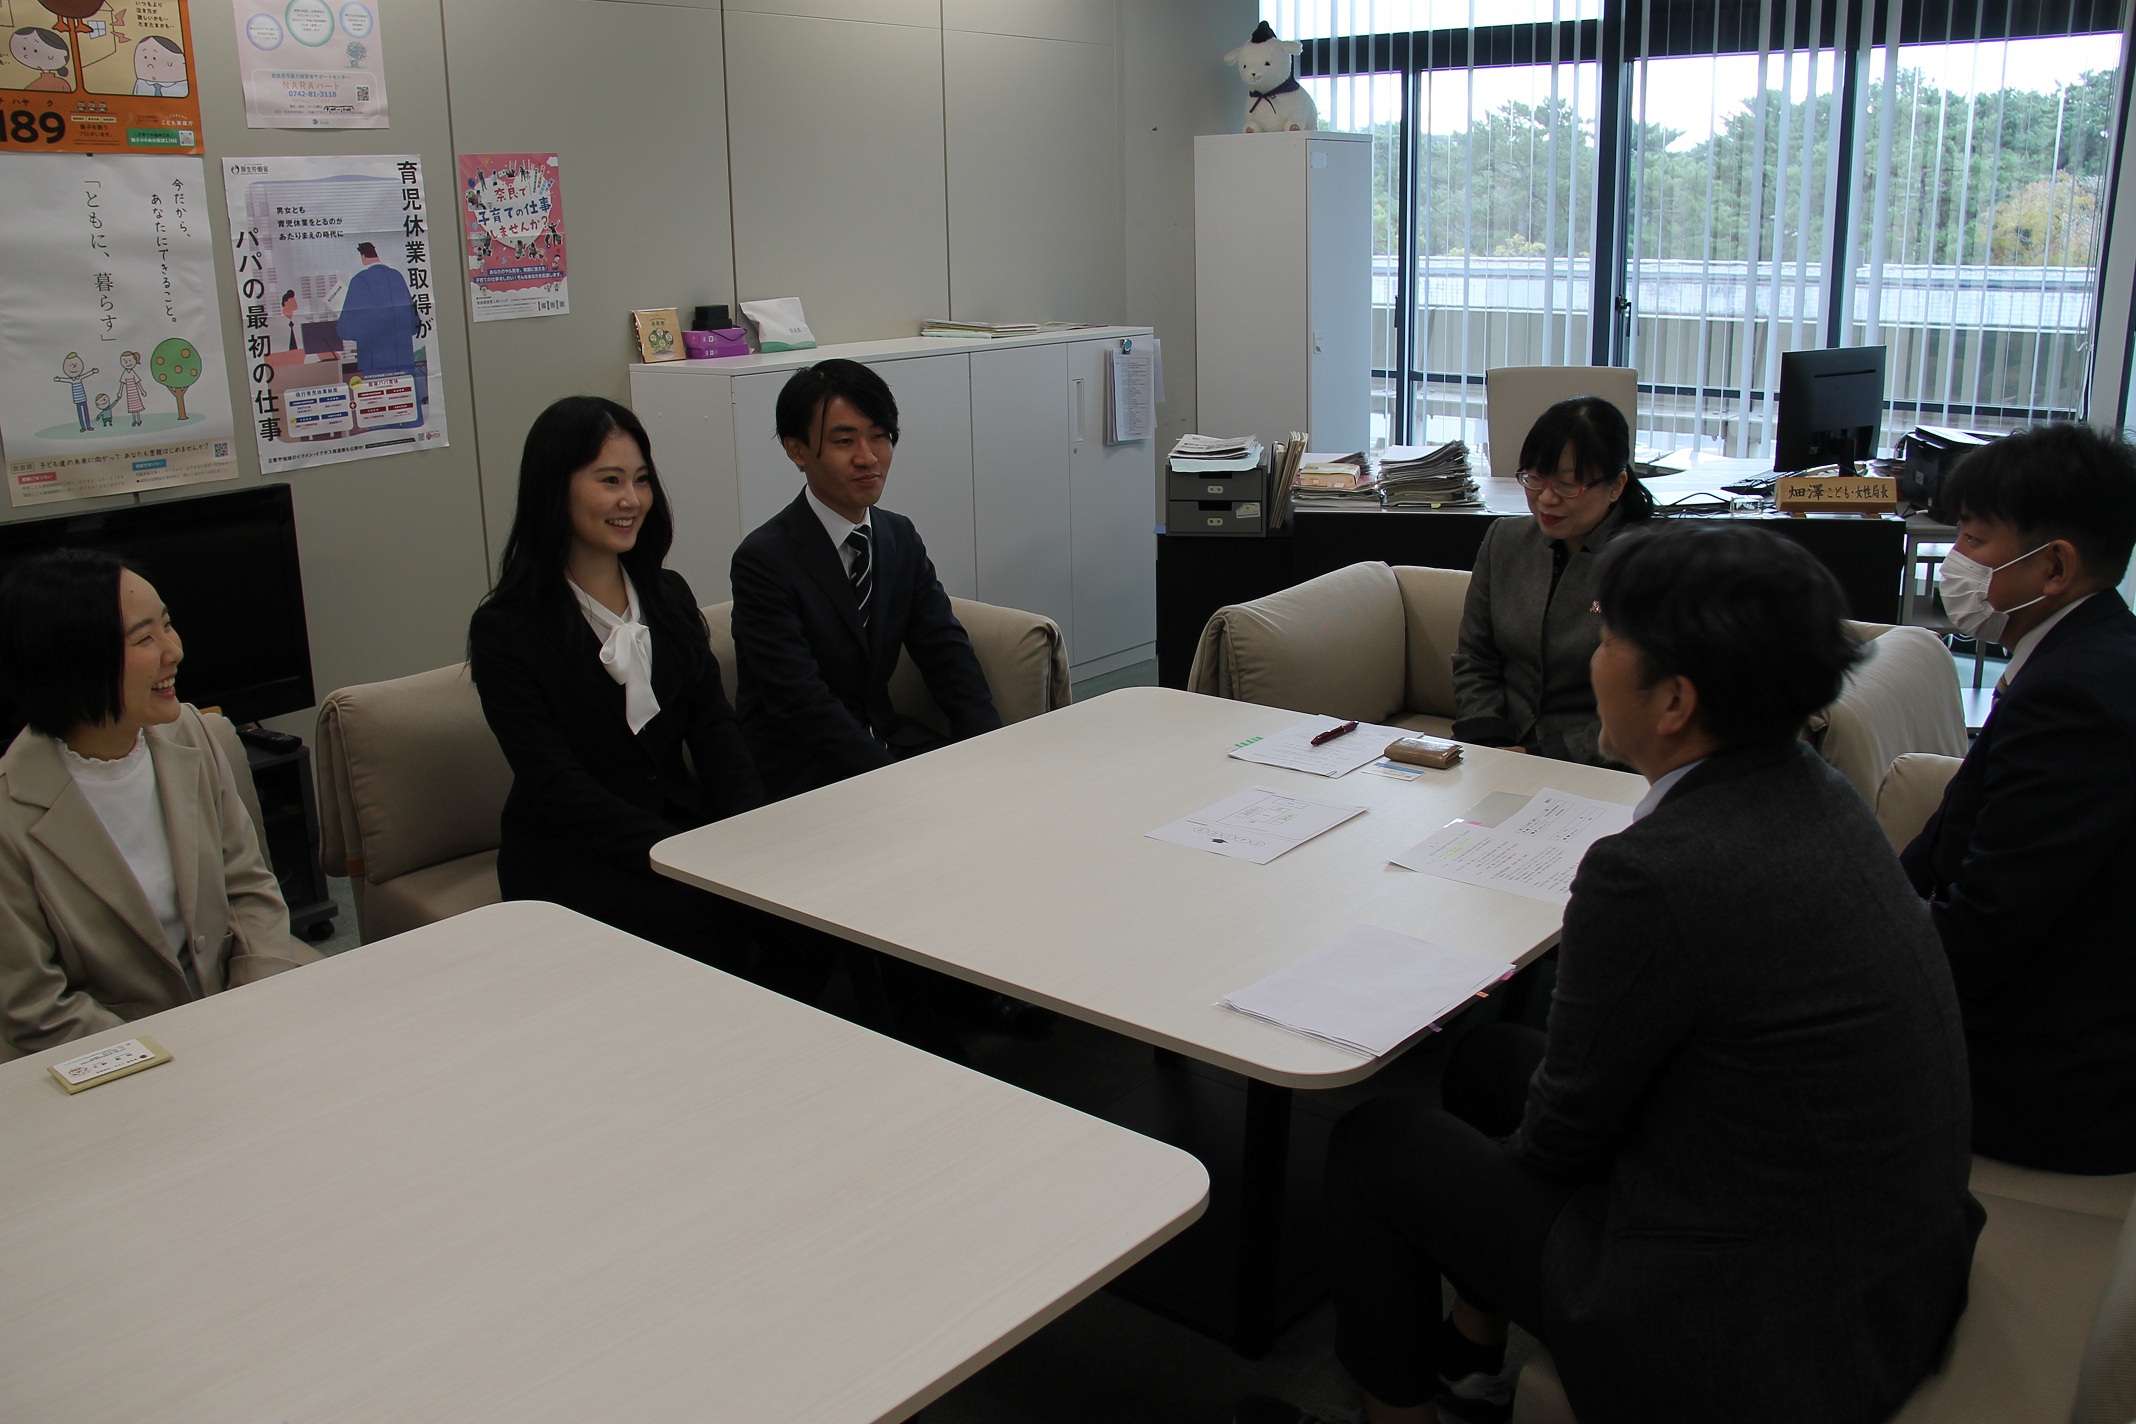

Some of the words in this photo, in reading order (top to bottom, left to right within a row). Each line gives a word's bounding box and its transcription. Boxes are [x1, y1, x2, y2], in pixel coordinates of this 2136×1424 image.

[494, 186, 527, 203] 奈良で
[172, 178, 191, 238] 今だから、
[276, 206, 306, 215] 男女とも
[478, 196, 551, 226] 子育ての仕事
[278, 217, 343, 228] 育児休業をとるのが
[279, 230, 344, 241] あたりまえの時代に
[151, 193, 177, 323] あなたにできること。
[397, 161, 434, 339] 育児休業取得が
[236, 227, 282, 441] パパの最初の仕事
[1827, 484, 1888, 499] こども・女性局長
